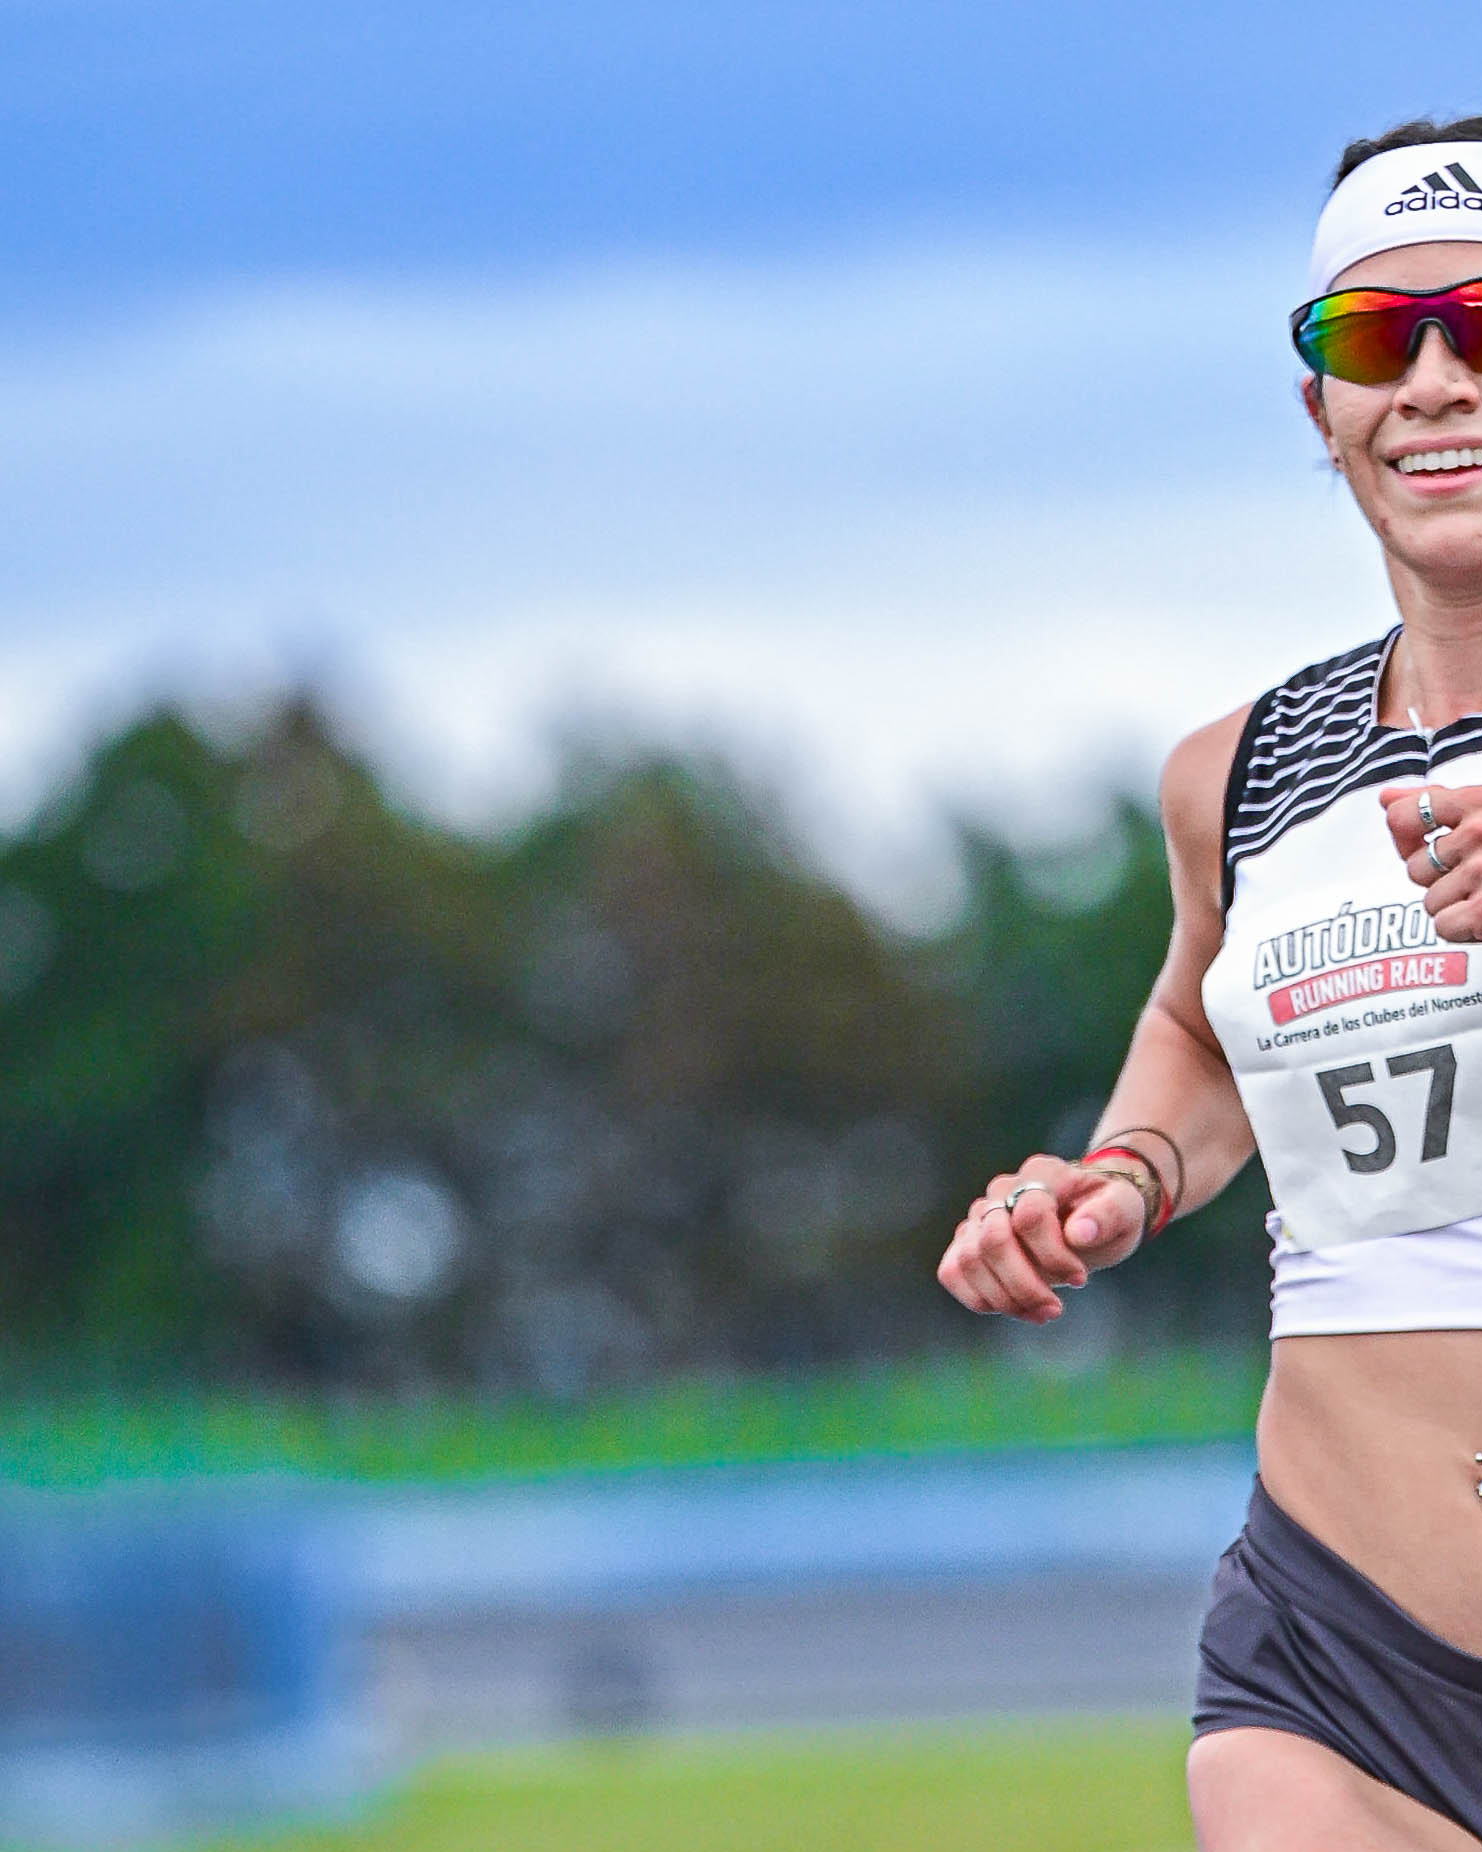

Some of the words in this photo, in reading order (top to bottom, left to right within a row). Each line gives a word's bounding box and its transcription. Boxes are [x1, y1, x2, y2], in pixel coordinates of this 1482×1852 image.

[1289, 964, 1384, 1016] RUNNING
[1390, 958, 1445, 987] RACE
[1256, 1037, 1272, 1051] La
[1273, 1026, 1320, 1048] Carrera
[1323, 1021, 1340, 1037] de
[1341, 1015, 1361, 1032] los
[1363, 1006, 1405, 1027] Clubes
[1408, 999, 1429, 1017] del
[1316, 1044, 1457, 1174] 57
